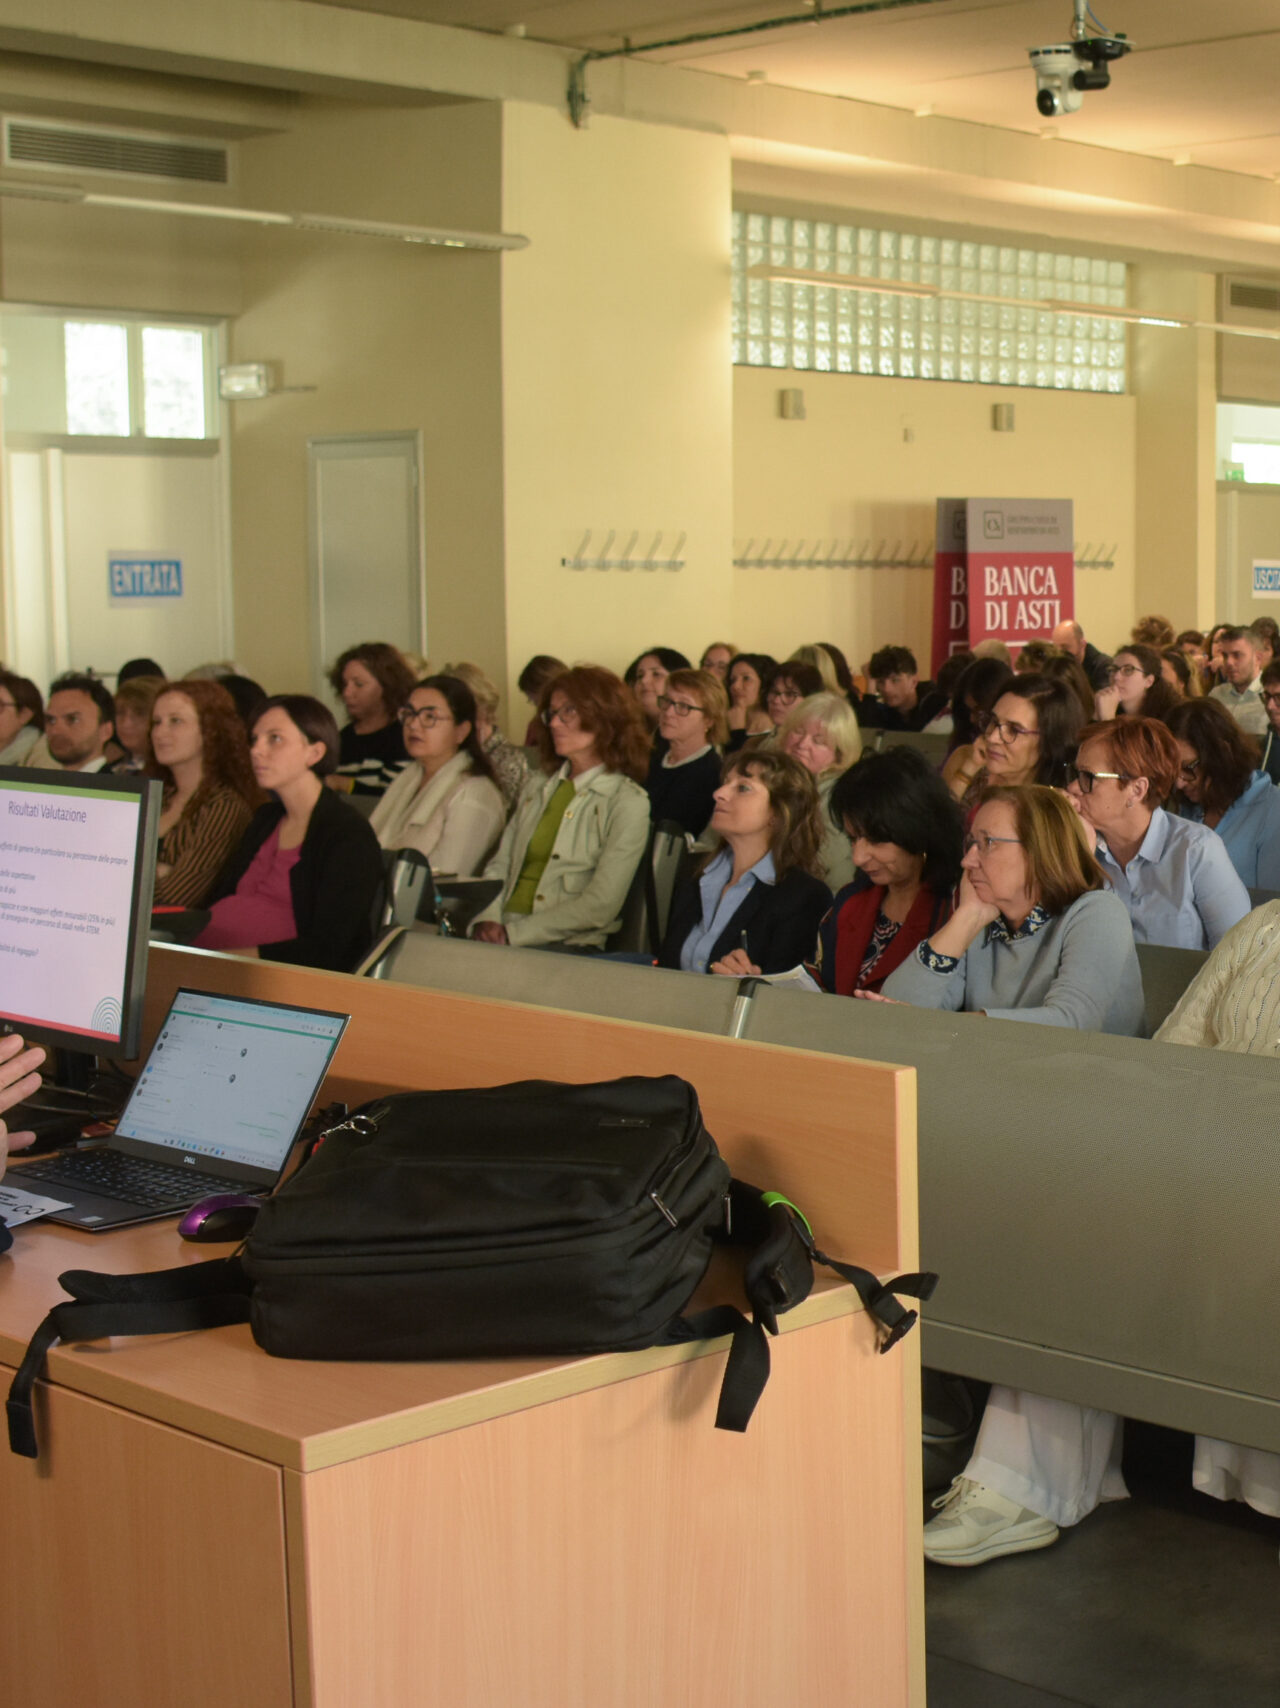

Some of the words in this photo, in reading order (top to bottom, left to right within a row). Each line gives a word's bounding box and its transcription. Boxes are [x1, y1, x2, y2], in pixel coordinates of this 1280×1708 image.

[112, 564, 180, 593] ENTRATA
[984, 565, 1059, 596] BANCA
[985, 600, 1008, 631] DI
[1014, 599, 1061, 630] ASTI
[8, 800, 39, 818] Risultati
[40, 804, 87, 823] Valutazione
